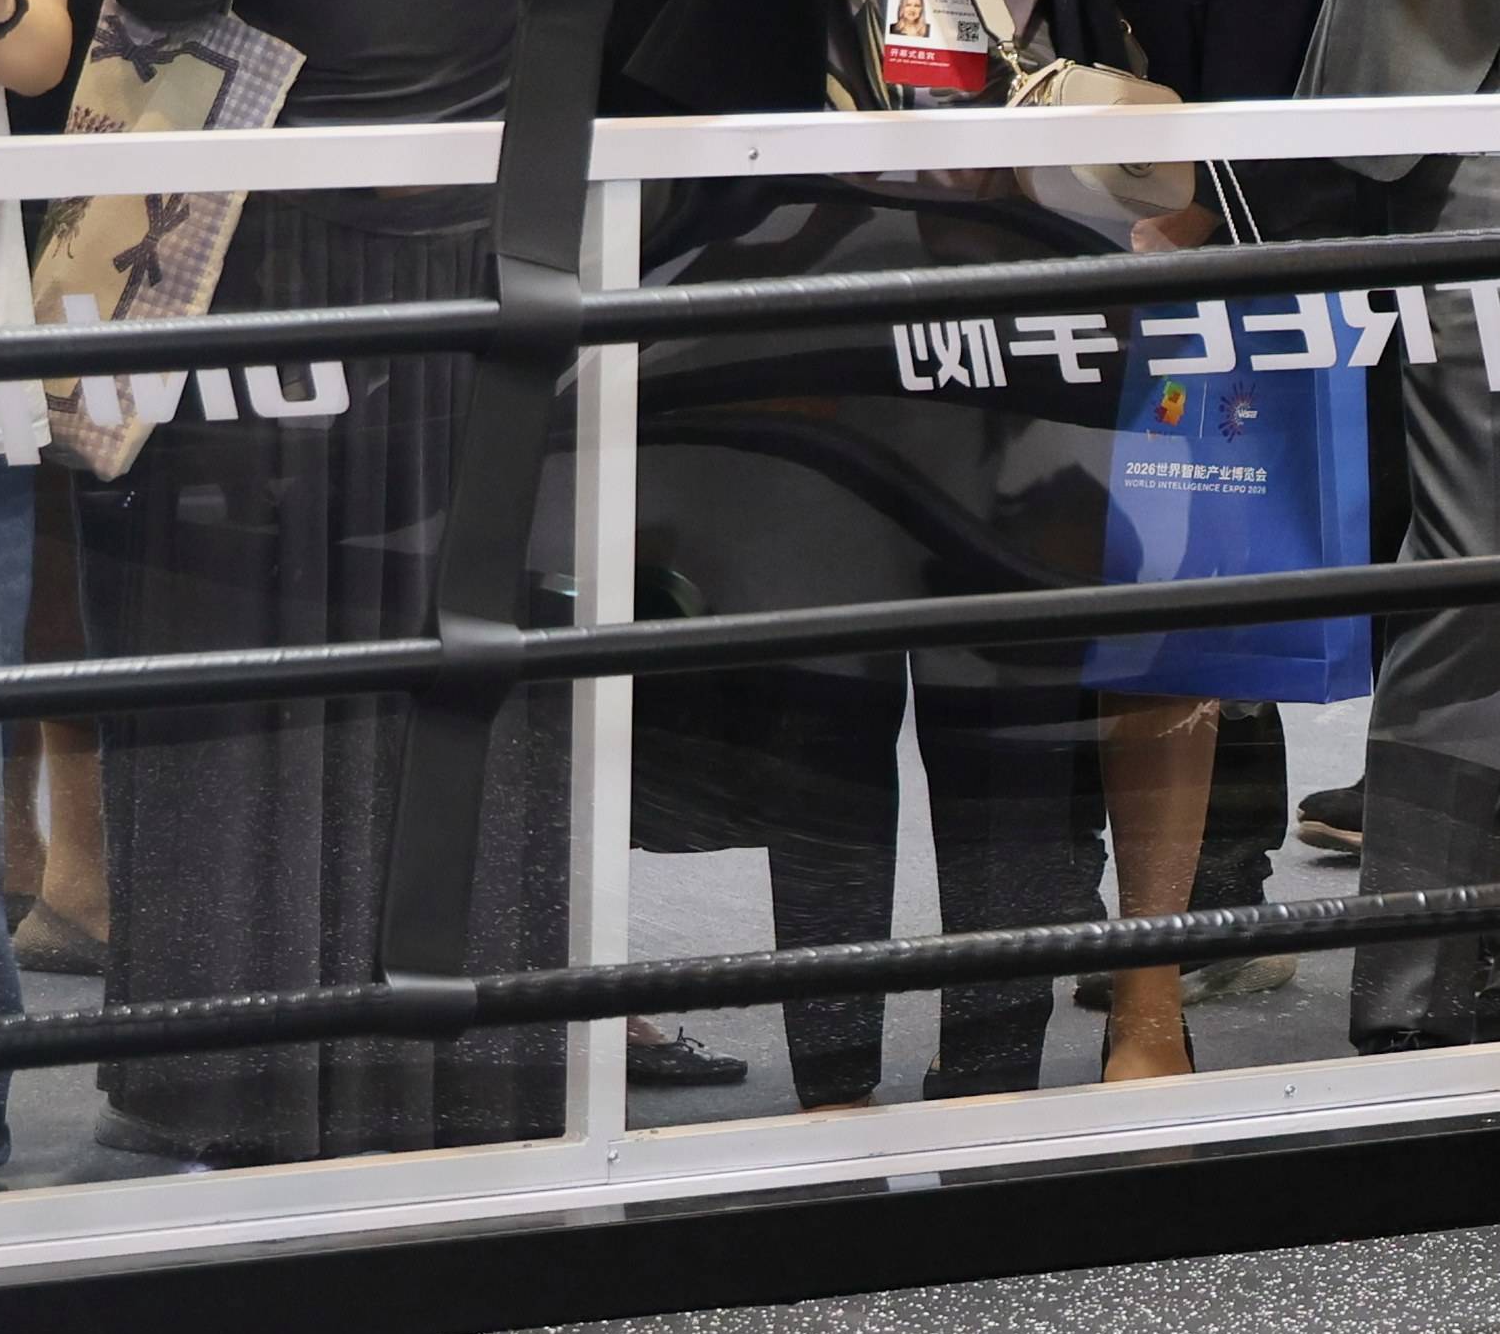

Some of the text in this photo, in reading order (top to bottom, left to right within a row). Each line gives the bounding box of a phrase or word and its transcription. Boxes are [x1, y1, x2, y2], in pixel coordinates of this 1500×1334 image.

[1125, 461, 1268, 484] 2026世界智能产业博览会
[1124, 478, 1157, 489] WORLD
[1157, 480, 1221, 493] INTELLIGENCE
[1222, 484, 1247, 494] EXPO
